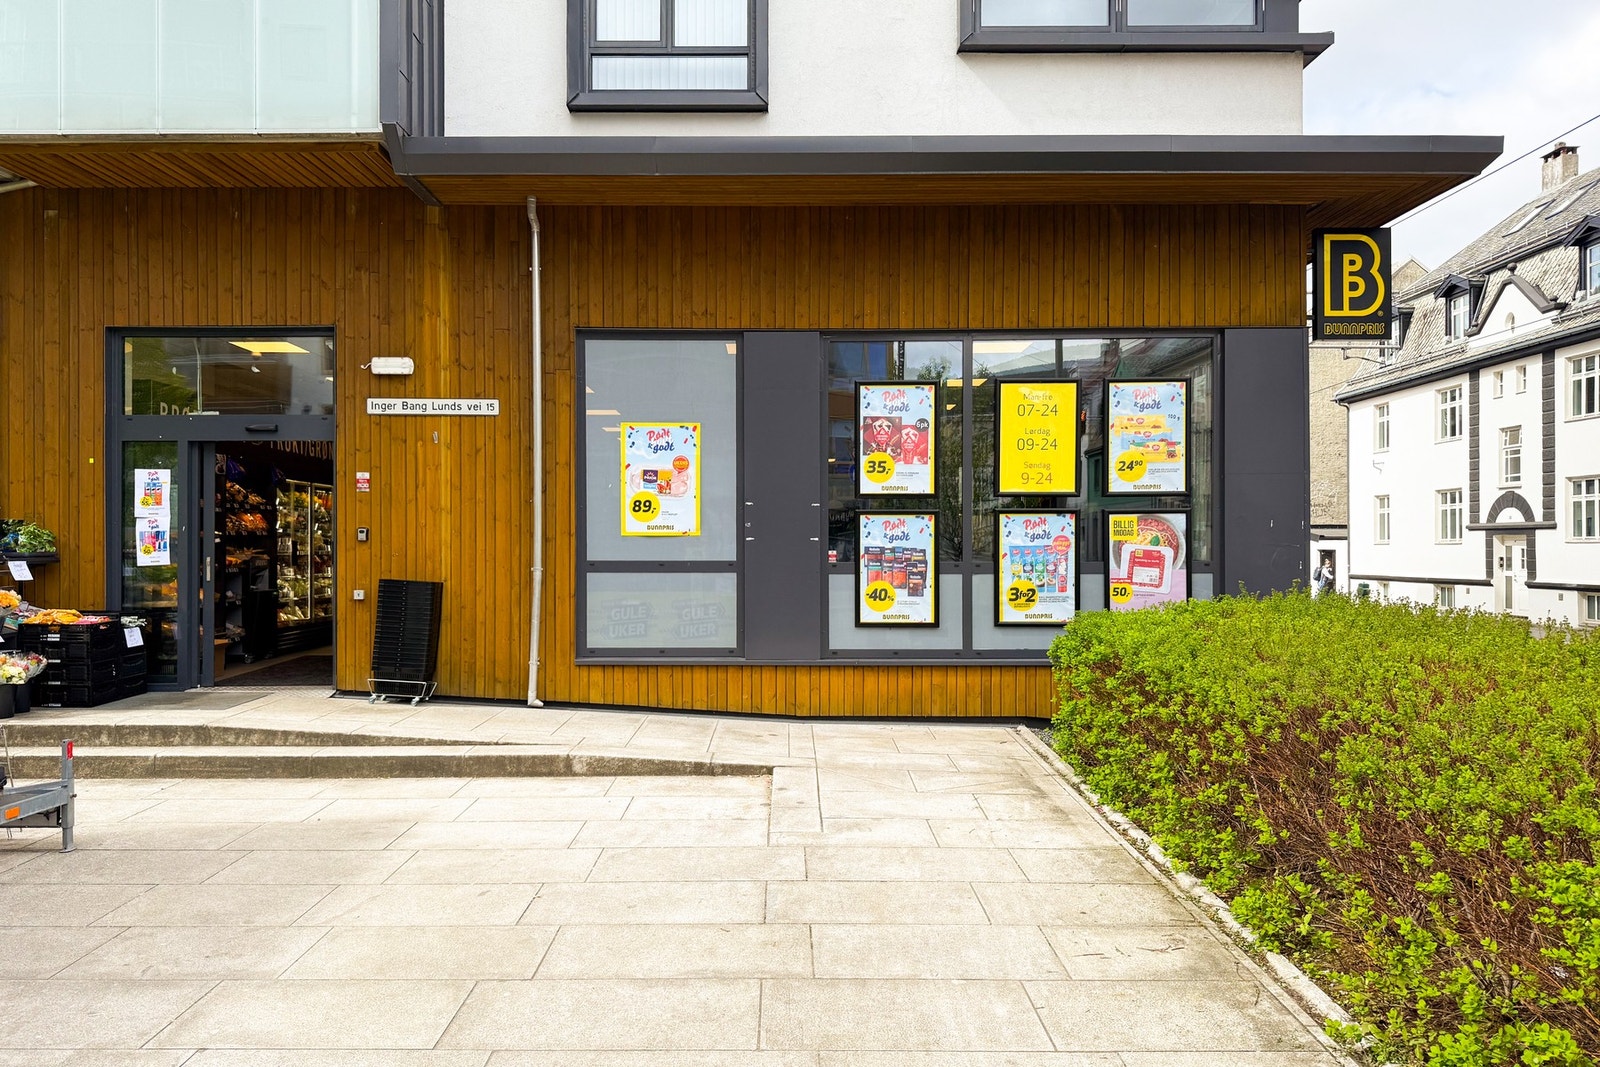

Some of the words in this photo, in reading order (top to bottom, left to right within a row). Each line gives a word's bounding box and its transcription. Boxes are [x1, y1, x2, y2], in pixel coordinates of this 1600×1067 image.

[1323, 322, 1386, 335] BUNNPRIS
[371, 401, 397, 413] Inger
[401, 401, 428, 413] Bang
[432, 401, 462, 411] Lunds
[467, 402, 482, 411] vei
[486, 403, 495, 412] 15
[1017, 403, 1059, 417] 07-24
[915, 420, 929, 429] 6pk
[1024, 428, 1051, 437] Lørdag
[652, 441, 675, 454] godt
[1016, 438, 1058, 451] 09-24
[1023, 461, 1051, 471] Søndag
[1020, 472, 1053, 485] 9-24
[1113, 520, 1135, 529] BILLIG
[888, 531, 911, 544] godt
[1029, 529, 1053, 543] godt
